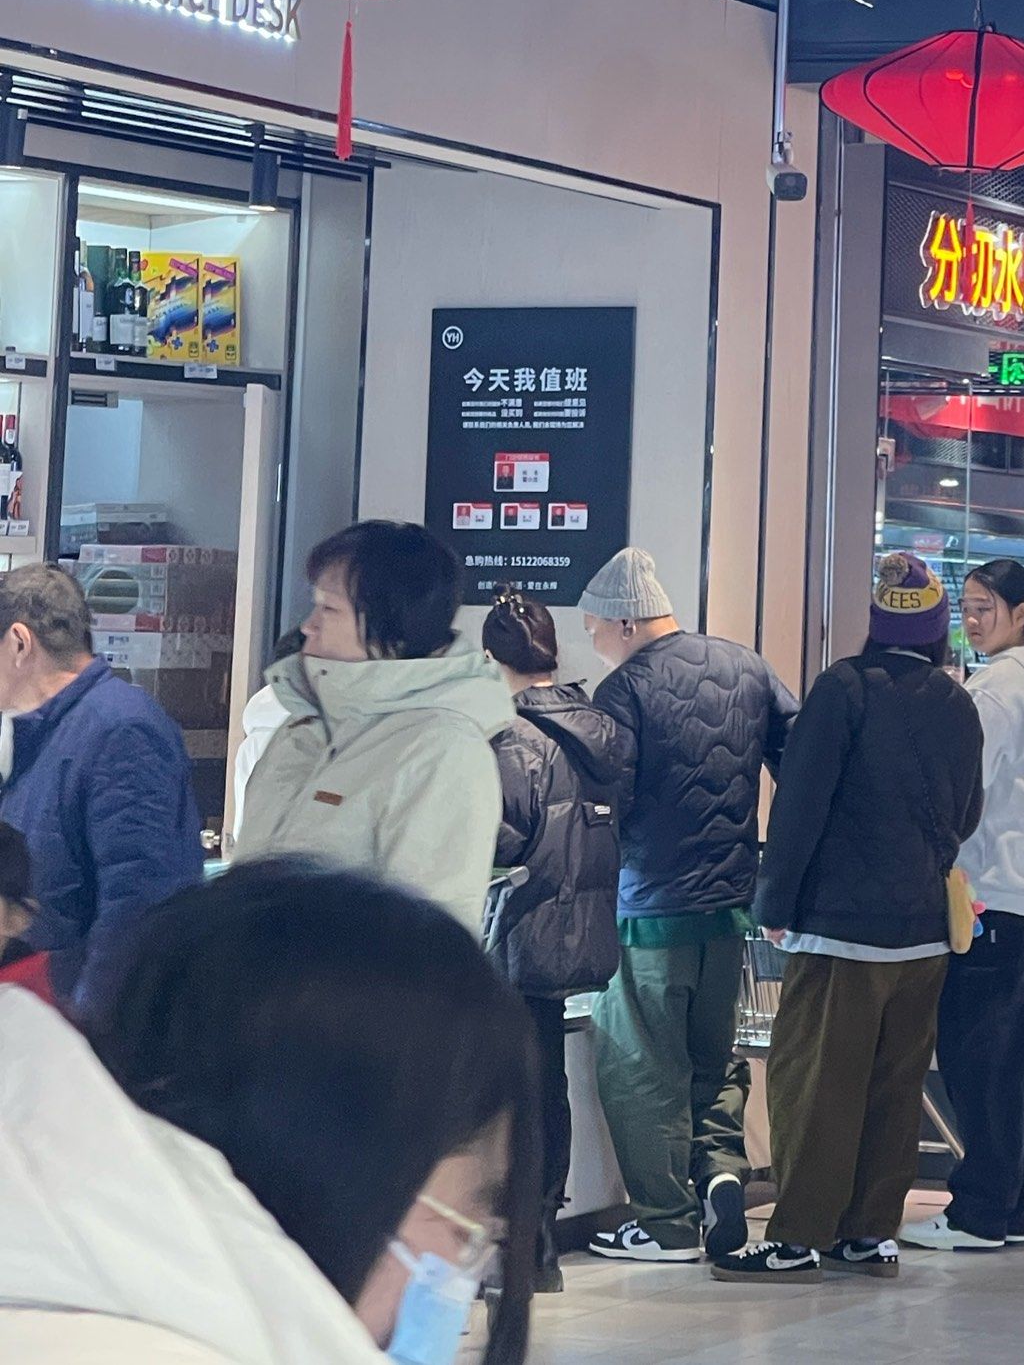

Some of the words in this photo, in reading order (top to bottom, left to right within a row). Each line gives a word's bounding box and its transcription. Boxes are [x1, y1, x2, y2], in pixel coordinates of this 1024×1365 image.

[463, 367, 588, 392] 今天我值班
